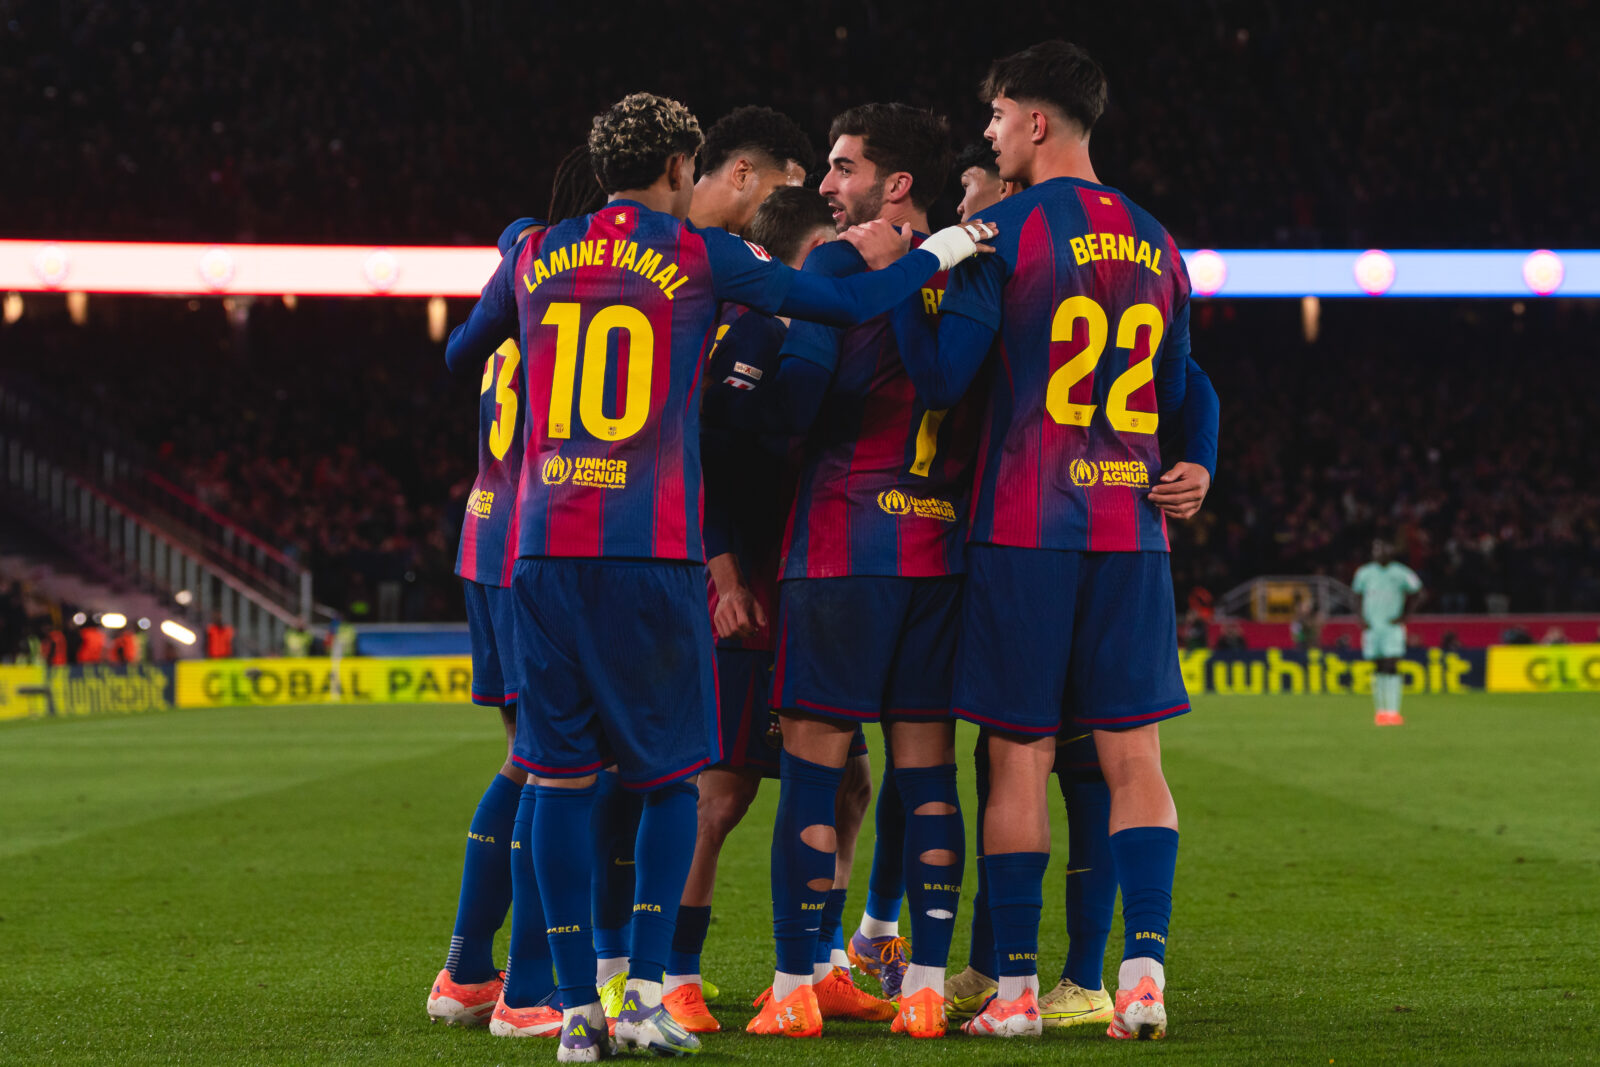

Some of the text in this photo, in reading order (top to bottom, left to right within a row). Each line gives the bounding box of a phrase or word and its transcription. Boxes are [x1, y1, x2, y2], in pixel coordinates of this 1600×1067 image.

[523, 239, 690, 300] LAMINE YAMAL
[1069, 232, 1162, 276] BERNAL
[541, 302, 654, 441] 10
[1045, 295, 1164, 434] 22
[572, 469, 626, 484] ACNUR
[575, 457, 627, 472] UNHCR
[1099, 461, 1148, 472] UNHCR
[1102, 471, 1150, 484] ACNUR
[202, 669, 373, 701] GLOBAL
